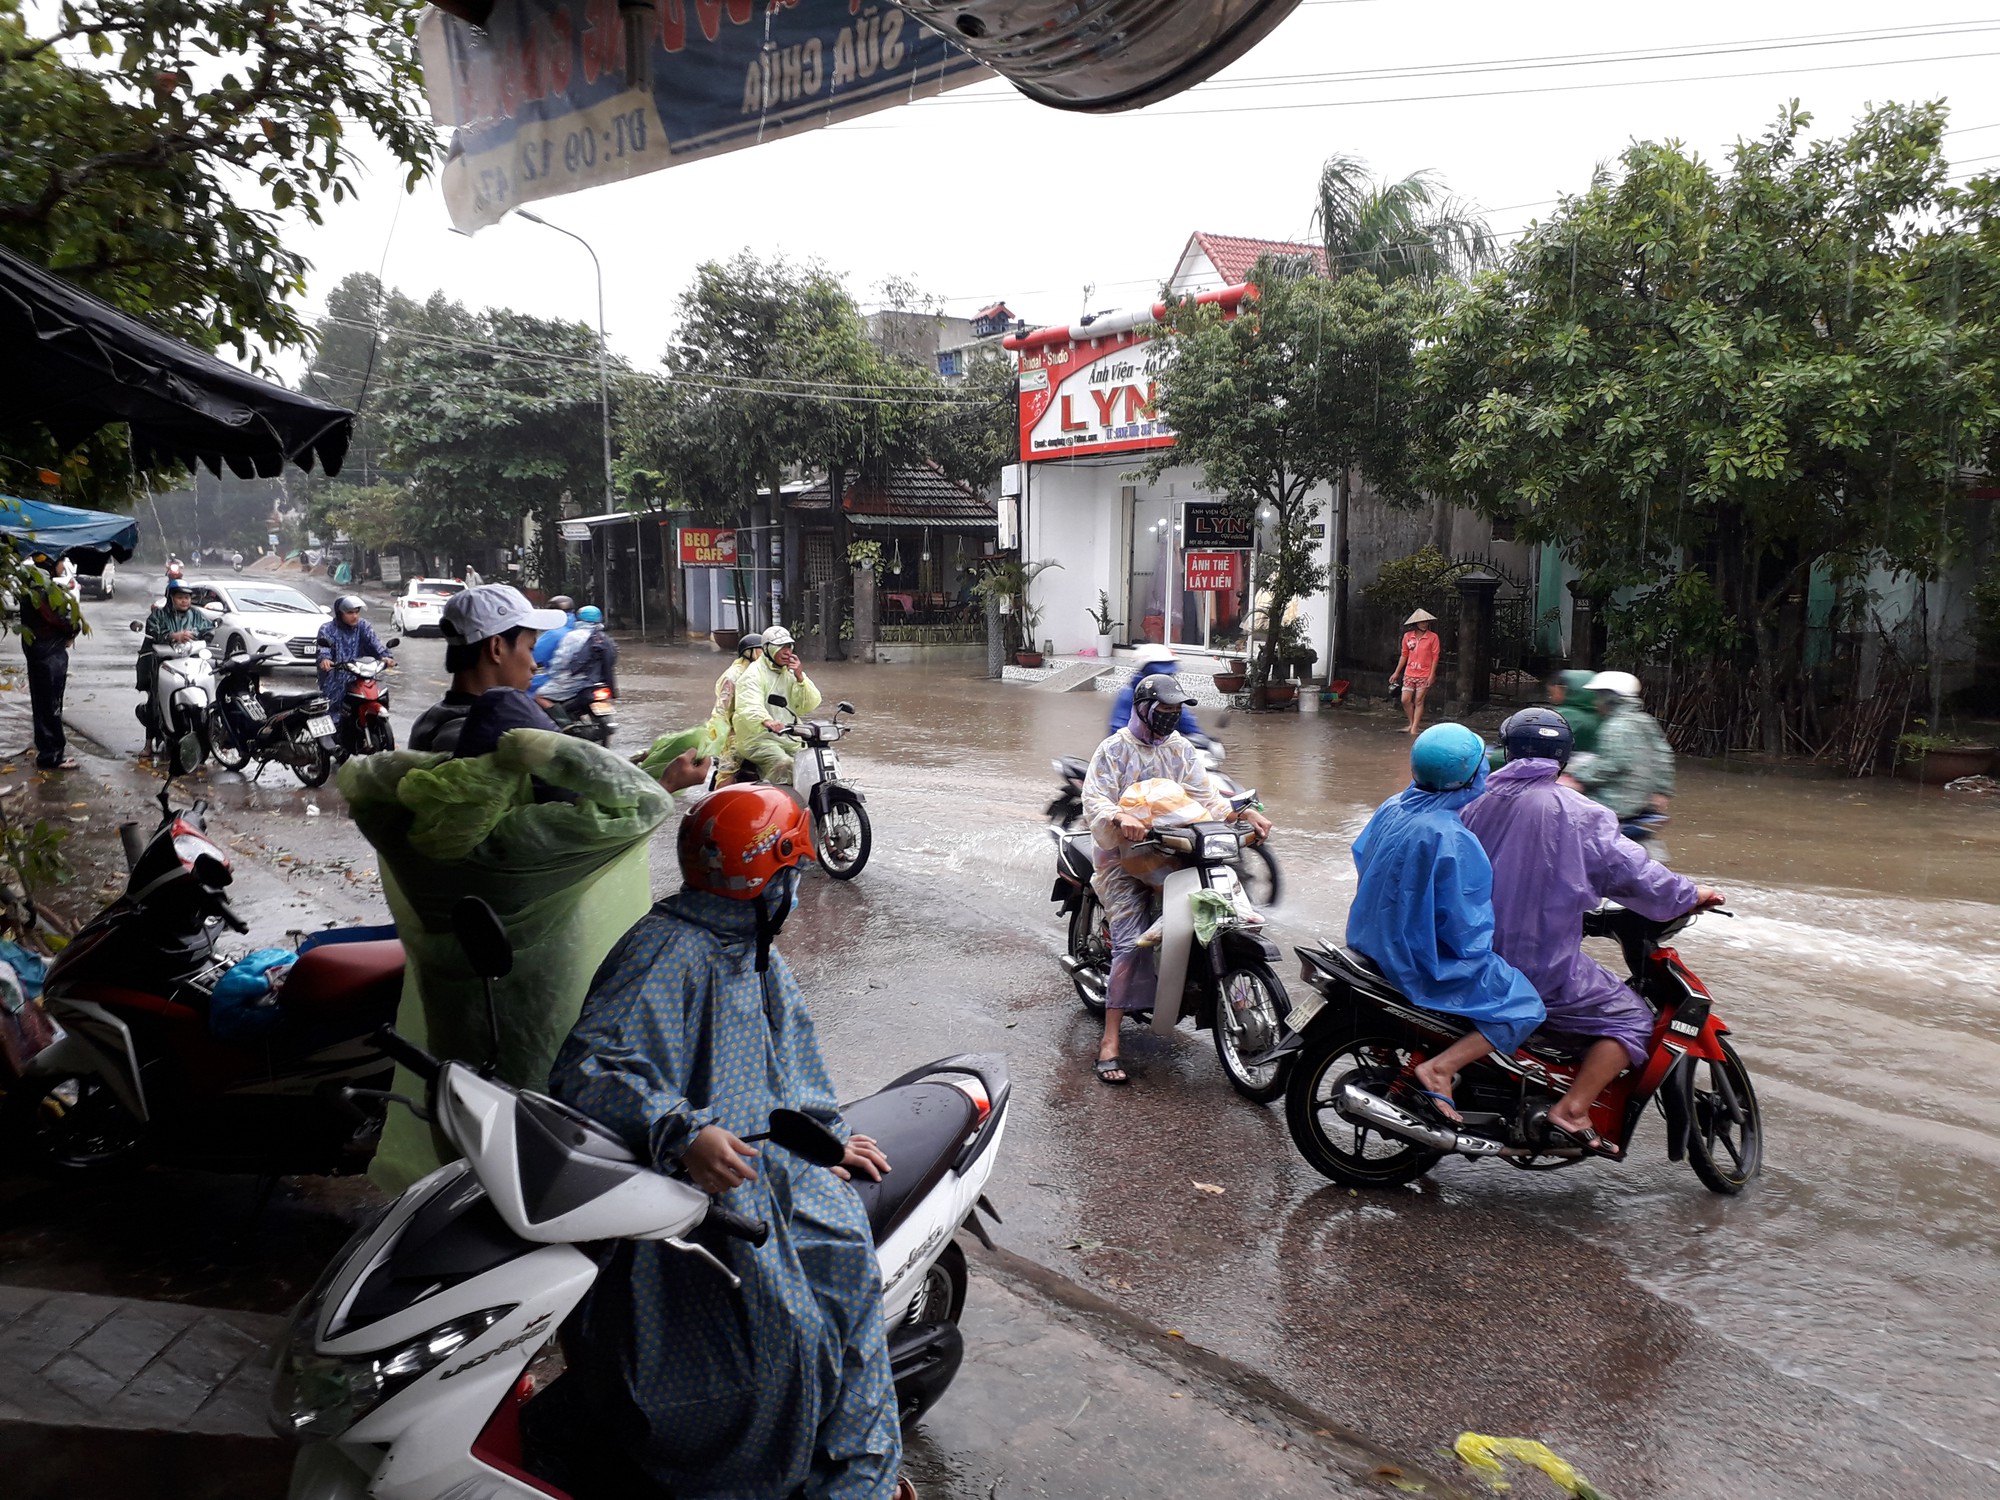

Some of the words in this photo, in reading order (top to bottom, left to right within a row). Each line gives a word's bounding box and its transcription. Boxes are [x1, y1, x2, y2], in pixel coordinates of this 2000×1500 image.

[1047, 349, 1069, 366] Studio
[1088, 362, 1110, 385] Ảnh
[1111, 361, 1135, 382] Viện
[1061, 382, 1159, 432] LYN
[1196, 517, 1246, 533] LYN
[683, 532, 710, 547] BEO
[1220, 533, 1249, 541] Wedding
[695, 547, 724, 561] CAFE
[1191, 555, 1210, 571] ẢNH
[1212, 555, 1230, 571] THẺ
[1189, 572, 1208, 588] LẤY
